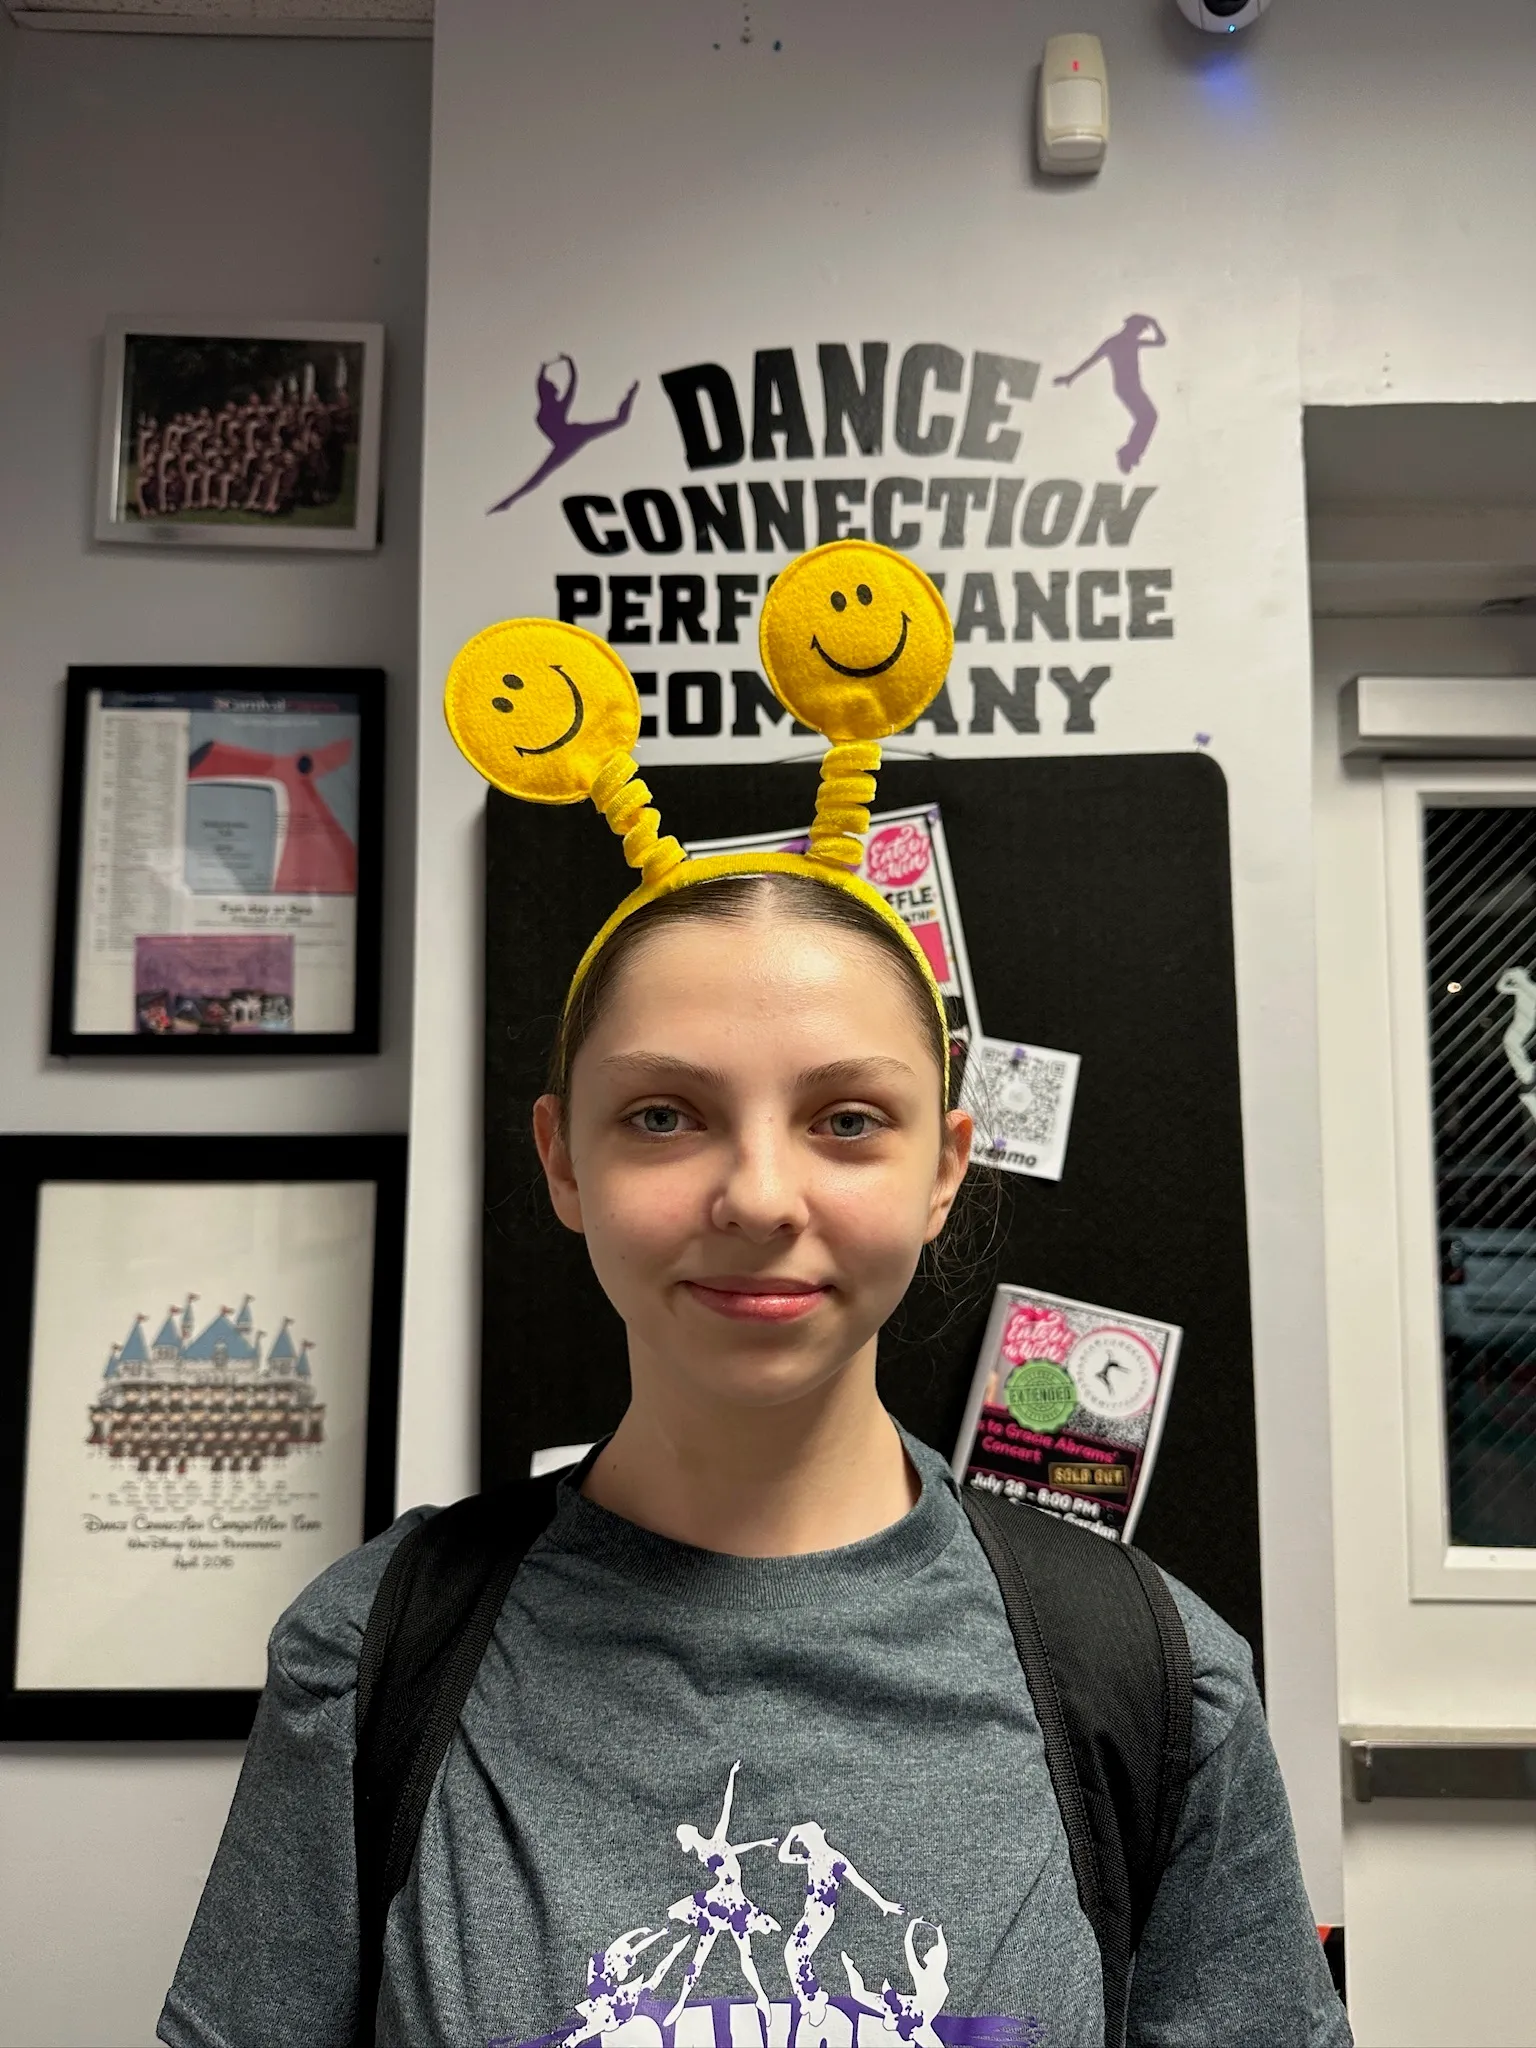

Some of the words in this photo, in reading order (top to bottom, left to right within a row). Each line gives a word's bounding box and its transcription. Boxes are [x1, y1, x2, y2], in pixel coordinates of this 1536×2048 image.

[660, 342, 1043, 471] DANCE
[560, 476, 1157, 556] CONNECTION
[555, 568, 1174, 645] PERFANCE
[638, 665, 1113, 739] OMANY
[885, 886, 934, 910] FFLE
[1009, 1386, 1071, 1405] EXTENDED
[982, 1435, 1042, 1464] Concert
[970, 1471, 1005, 1497] July
[1072, 1496, 1101, 1520] PM
[1053, 1466, 1092, 1485] SOLD
[1093, 1468, 1123, 1487] OUT
